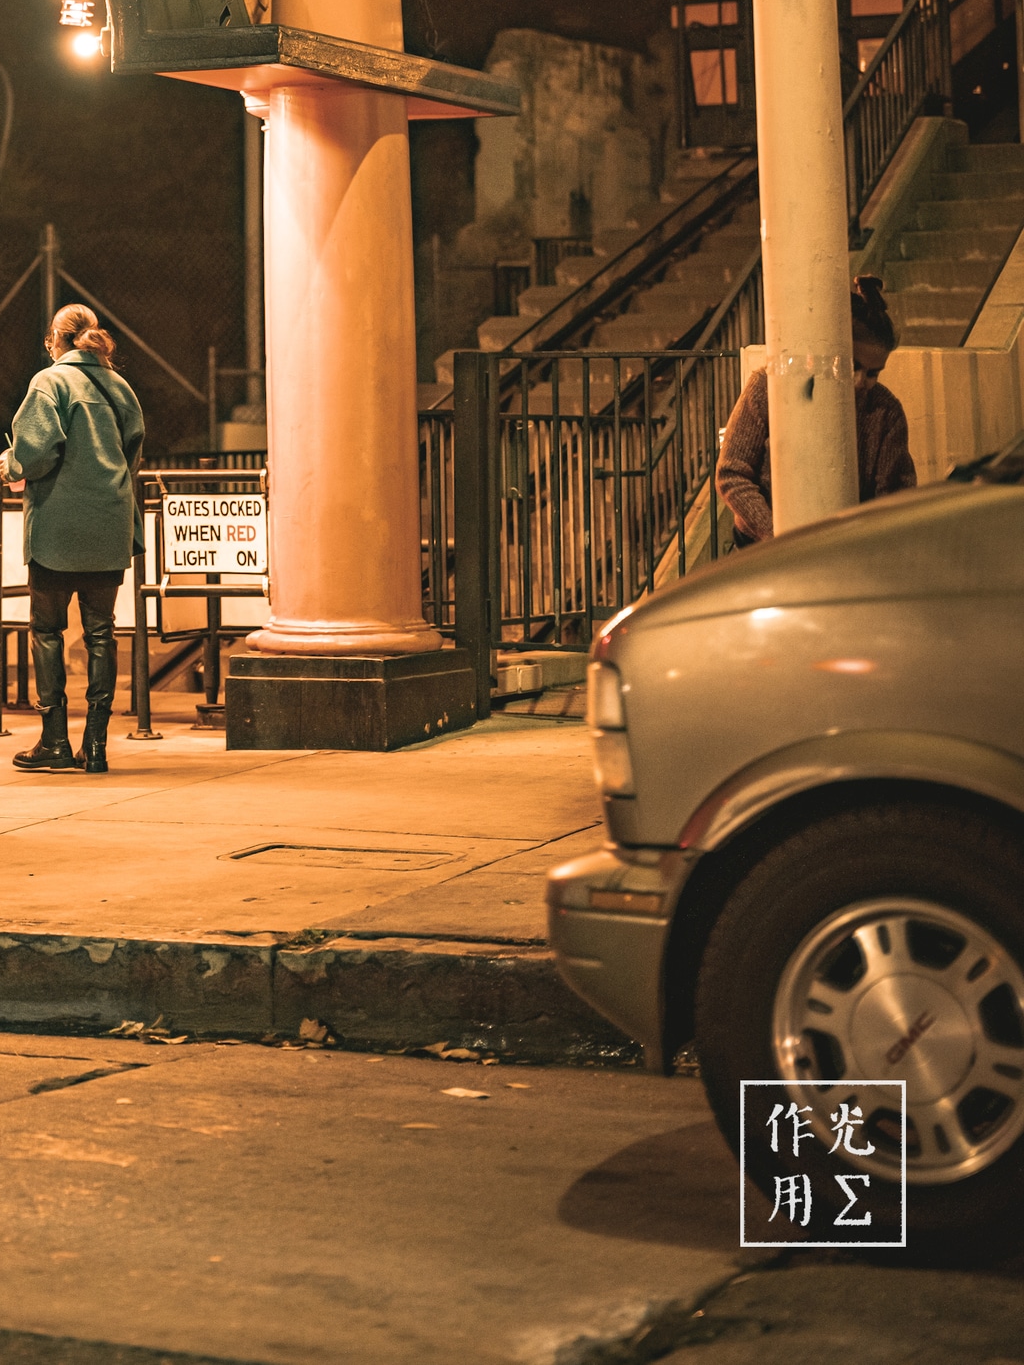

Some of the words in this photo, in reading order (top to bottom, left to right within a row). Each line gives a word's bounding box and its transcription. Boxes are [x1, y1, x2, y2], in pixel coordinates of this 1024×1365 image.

[167, 500, 210, 517] GATES
[212, 500, 262, 517] LOCKED
[173, 524, 221, 542] WHEN
[226, 524, 257, 542] RED
[173, 550, 217, 566] LIGHT
[236, 550, 257, 566] ON
[886, 1011, 937, 1065] GMC
